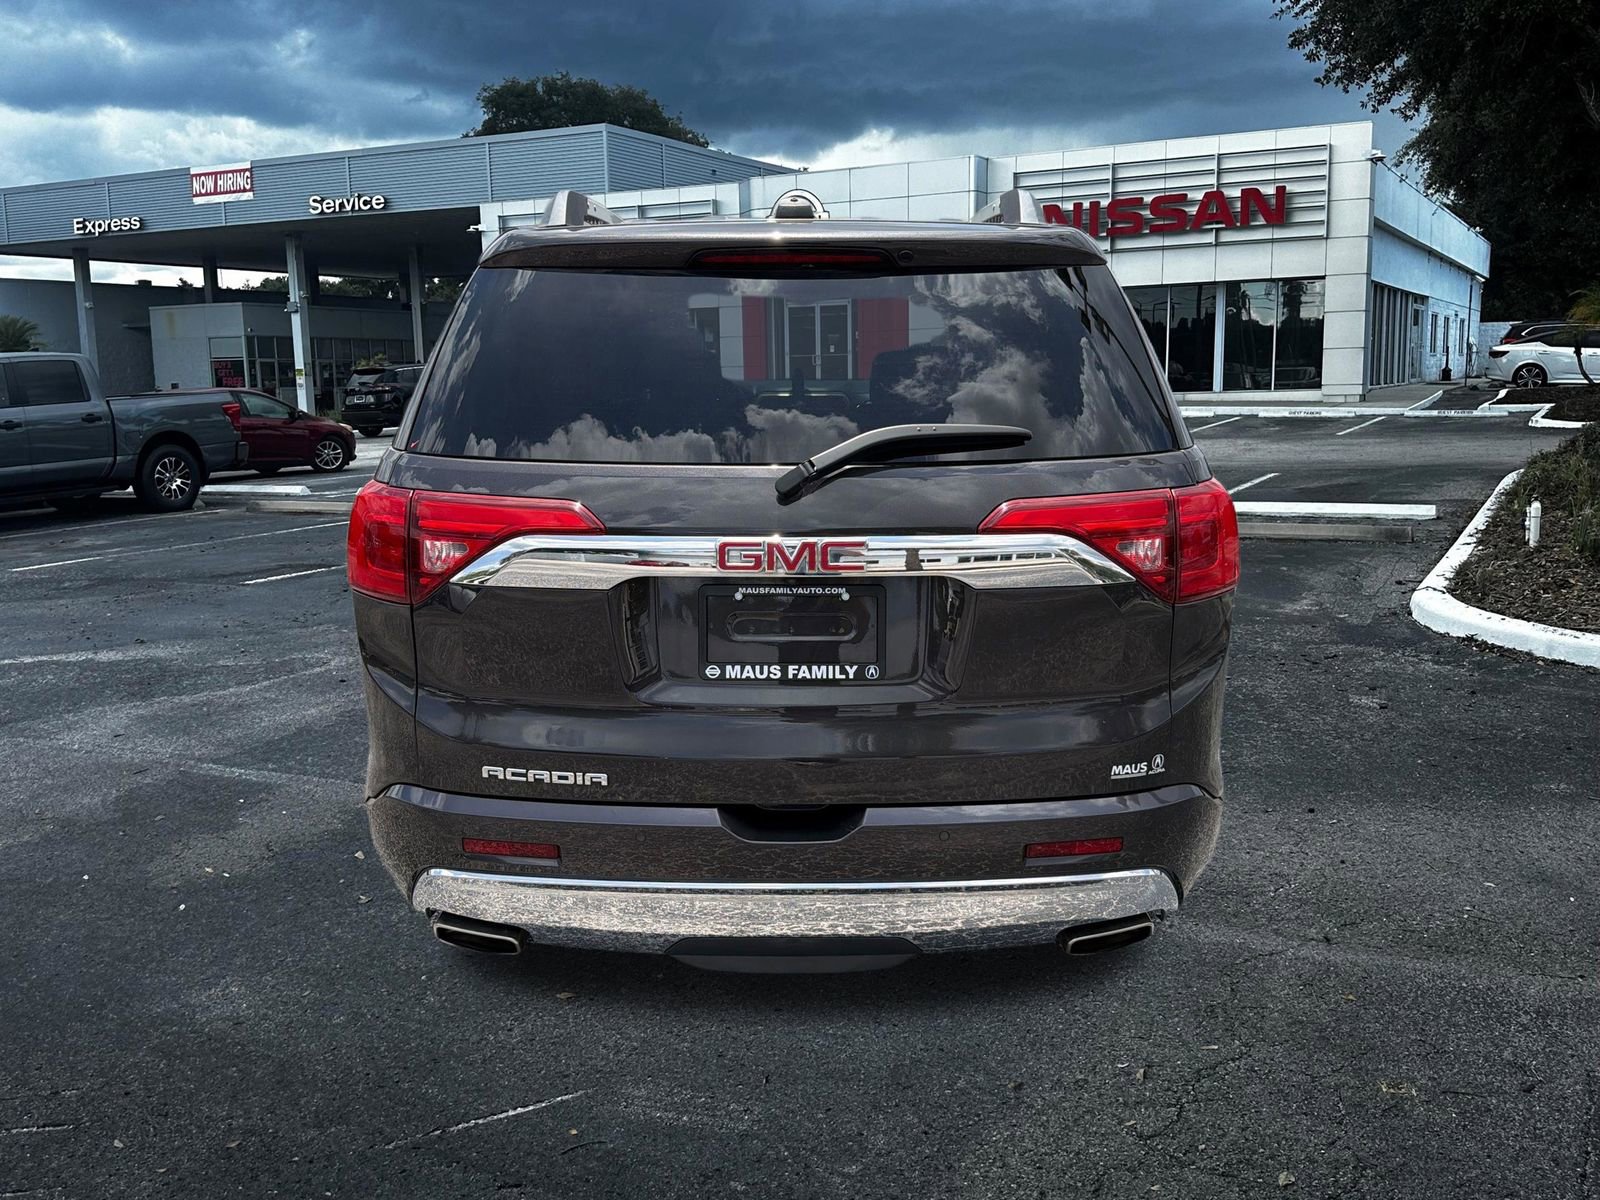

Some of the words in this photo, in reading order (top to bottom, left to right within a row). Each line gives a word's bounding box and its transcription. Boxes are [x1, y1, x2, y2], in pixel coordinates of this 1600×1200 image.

[192, 175, 215, 195] NOW
[217, 170, 251, 192] HIRING
[309, 193, 385, 215] Service
[1043, 185, 1286, 237] NISSAN
[73, 216, 141, 236] Express
[222, 377, 244, 386] FREE
[717, 541, 867, 572] GMC
[725, 665, 781, 679] MAUS
[788, 665, 858, 679] FAMILY
[482, 766, 608, 786] ACADIA
[1111, 762, 1148, 775] MAUS
